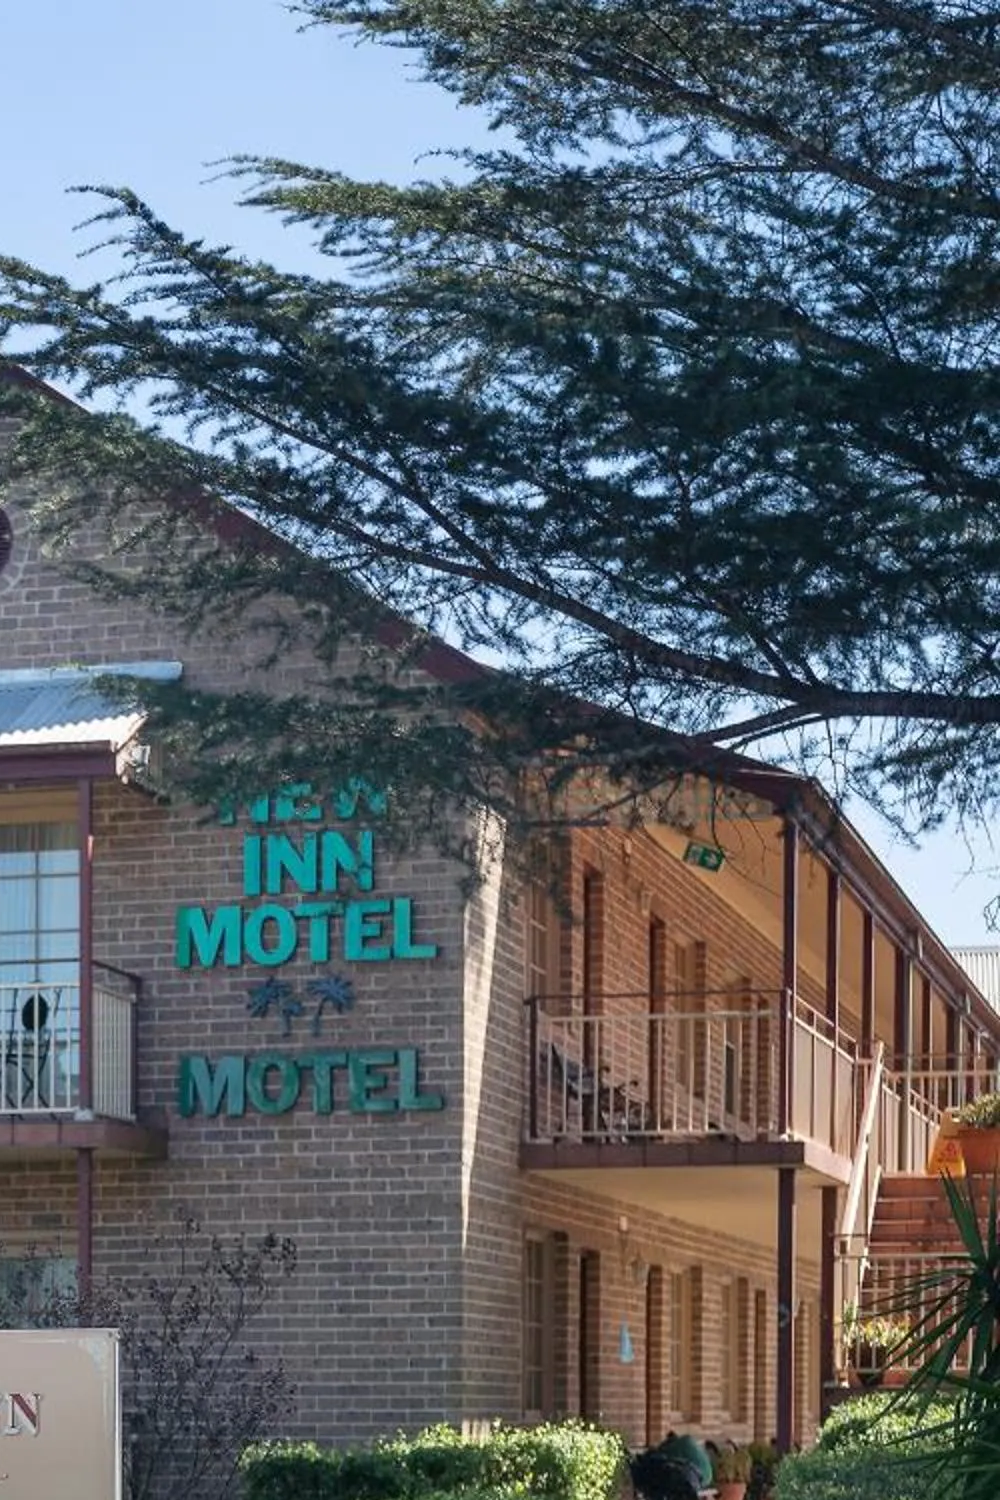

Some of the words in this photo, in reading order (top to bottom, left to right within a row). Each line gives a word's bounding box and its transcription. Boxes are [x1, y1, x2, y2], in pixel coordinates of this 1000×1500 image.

[243, 831, 374, 896] INN
[175, 897, 439, 968] MOTEL
[179, 1048, 443, 1117] MOTEL
